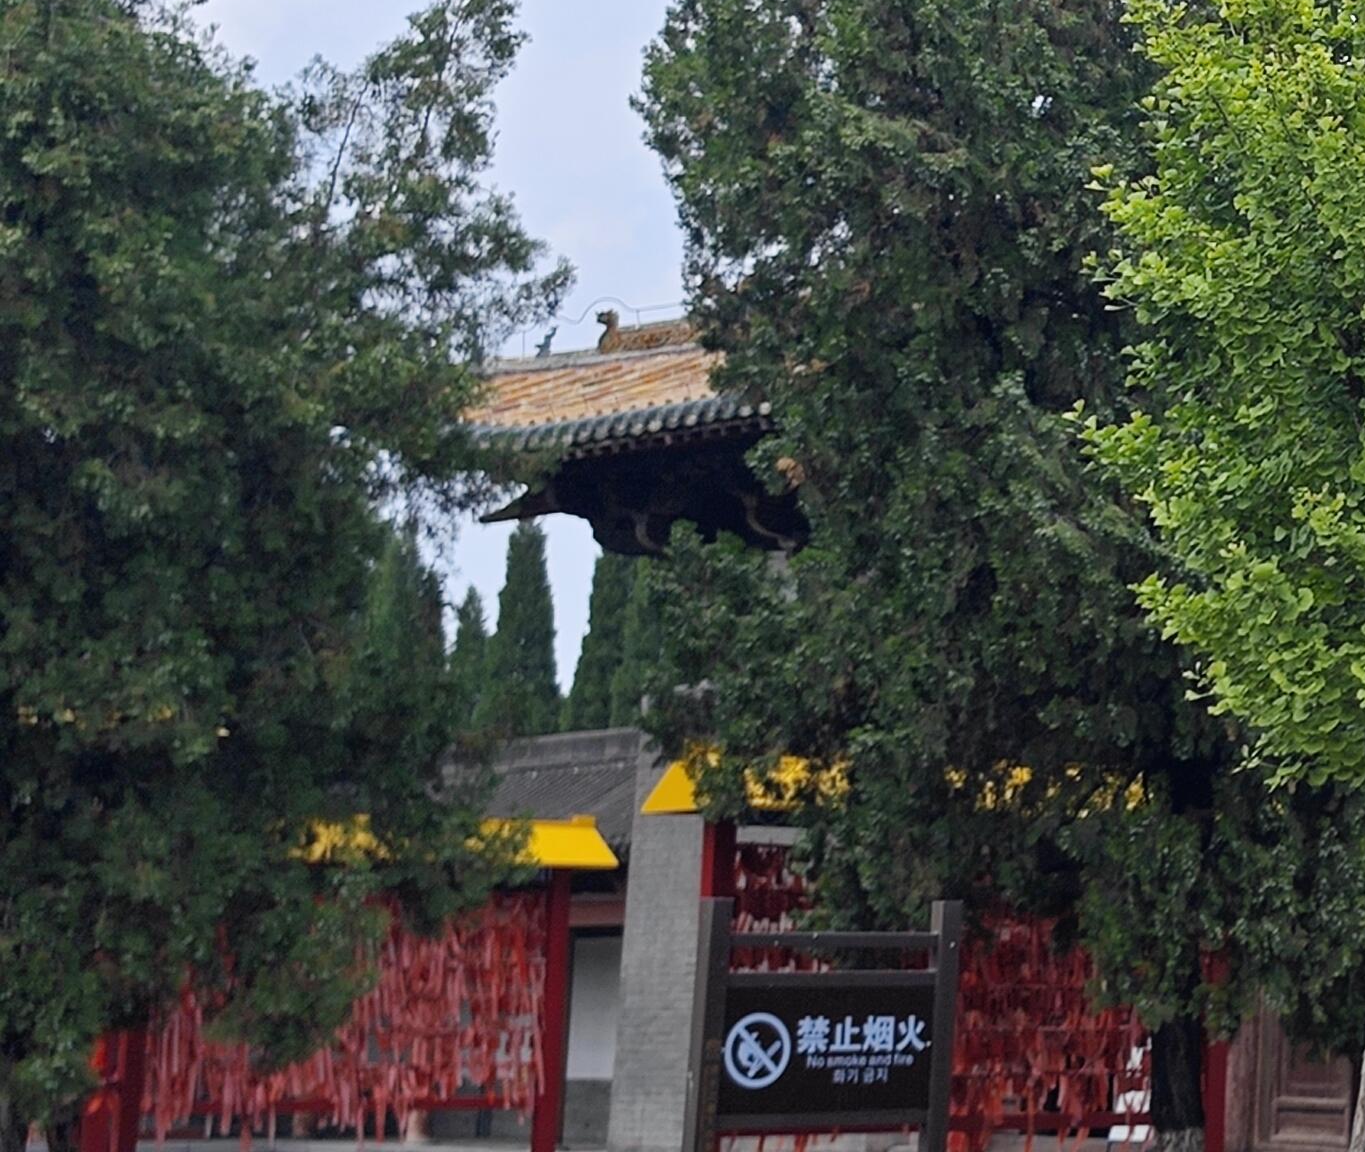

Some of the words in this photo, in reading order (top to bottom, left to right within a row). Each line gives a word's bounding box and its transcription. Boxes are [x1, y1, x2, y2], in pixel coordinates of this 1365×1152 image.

[797, 1014, 925, 1054] 禁止烟火
[806, 1055, 825, 1068] No
[869, 1054, 892, 1066] and
[893, 1053, 914, 1066] fire
